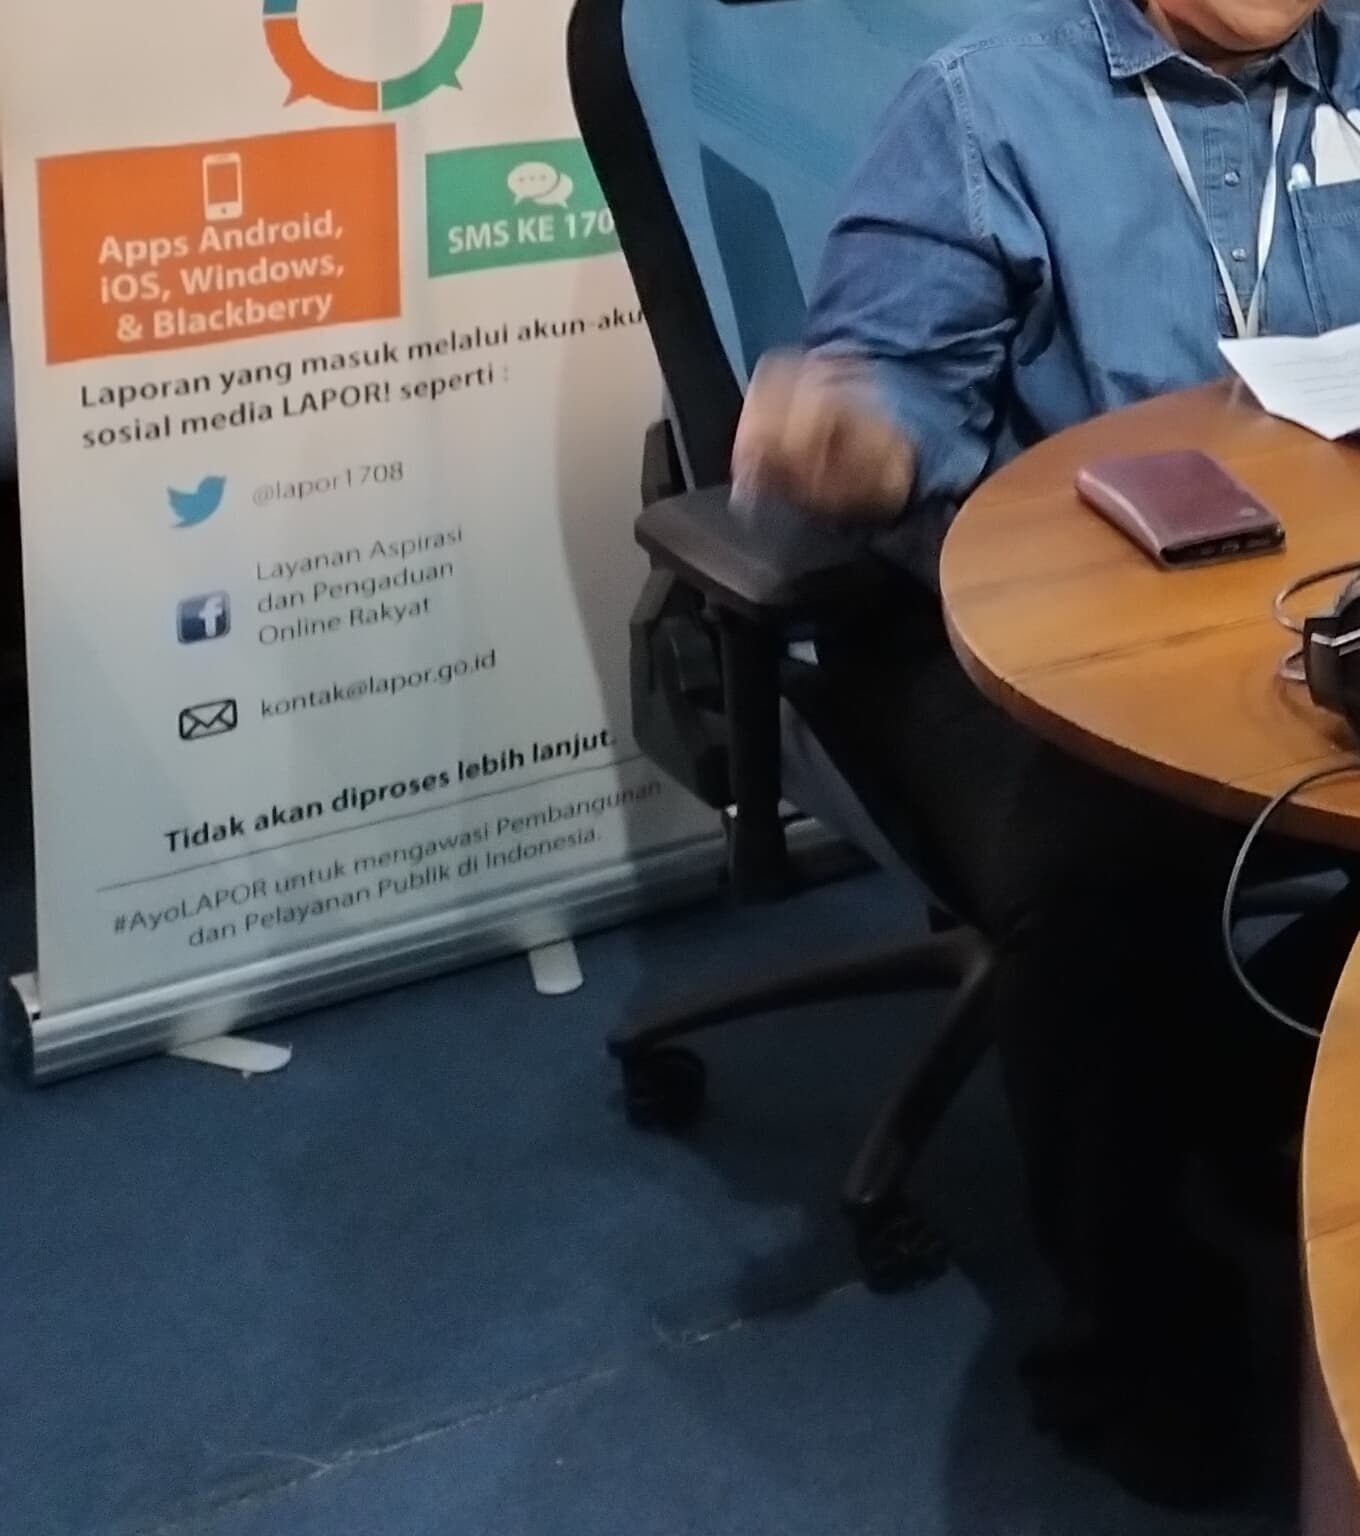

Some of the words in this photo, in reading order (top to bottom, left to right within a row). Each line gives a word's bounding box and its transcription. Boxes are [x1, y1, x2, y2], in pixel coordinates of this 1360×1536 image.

[98, 235, 189, 269] Apps
[198, 209, 344, 254] Android,
[448, 218, 509, 255] SMS
[517, 215, 555, 245] KE
[565, 208, 616, 241] 170
[100, 271, 172, 305] iOS,
[180, 254, 345, 296] Windows,
[116, 314, 144, 343] &
[153, 292, 333, 340] Blackberry
[80, 374, 211, 409] Laporan
[219, 361, 293, 396] yang
[301, 341, 399, 376] masuk
[407, 324, 509, 361] melalui
[517, 307, 643, 342] akun-aku
[82, 415, 171, 449] sosial
[181, 401, 274, 436] media
[282, 382, 391, 418] LAPOR!
[400, 362, 494, 400] seperti
[252, 461, 404, 506] @lapor1708
[256, 547, 361, 582] Layanan
[368, 524, 463, 559] Aspirasi
[256, 588, 304, 615] dan
[312, 560, 454, 603] Pengaduan
[258, 613, 341, 646] Online
[349, 596, 432, 628] Rakyat
[260, 649, 497, 720] kontak@lapor.go.id
[164, 816, 246, 853] Tidak
[253, 800, 324, 833] akan
[331, 769, 450, 812] diproses
[456, 748, 525, 782] lebih
[113, 878, 268, 935] #AyoLAPOR
[275, 859, 347, 895] untuk
[353, 822, 489, 874] mengawasi
[496, 780, 662, 837] Pembangunan
[188, 921, 237, 949] dan
[245, 884, 371, 933] Pelayanan
[378, 865, 450, 899] Publik
[457, 856, 479, 878] di
[486, 828, 602, 870] Indonesia.
